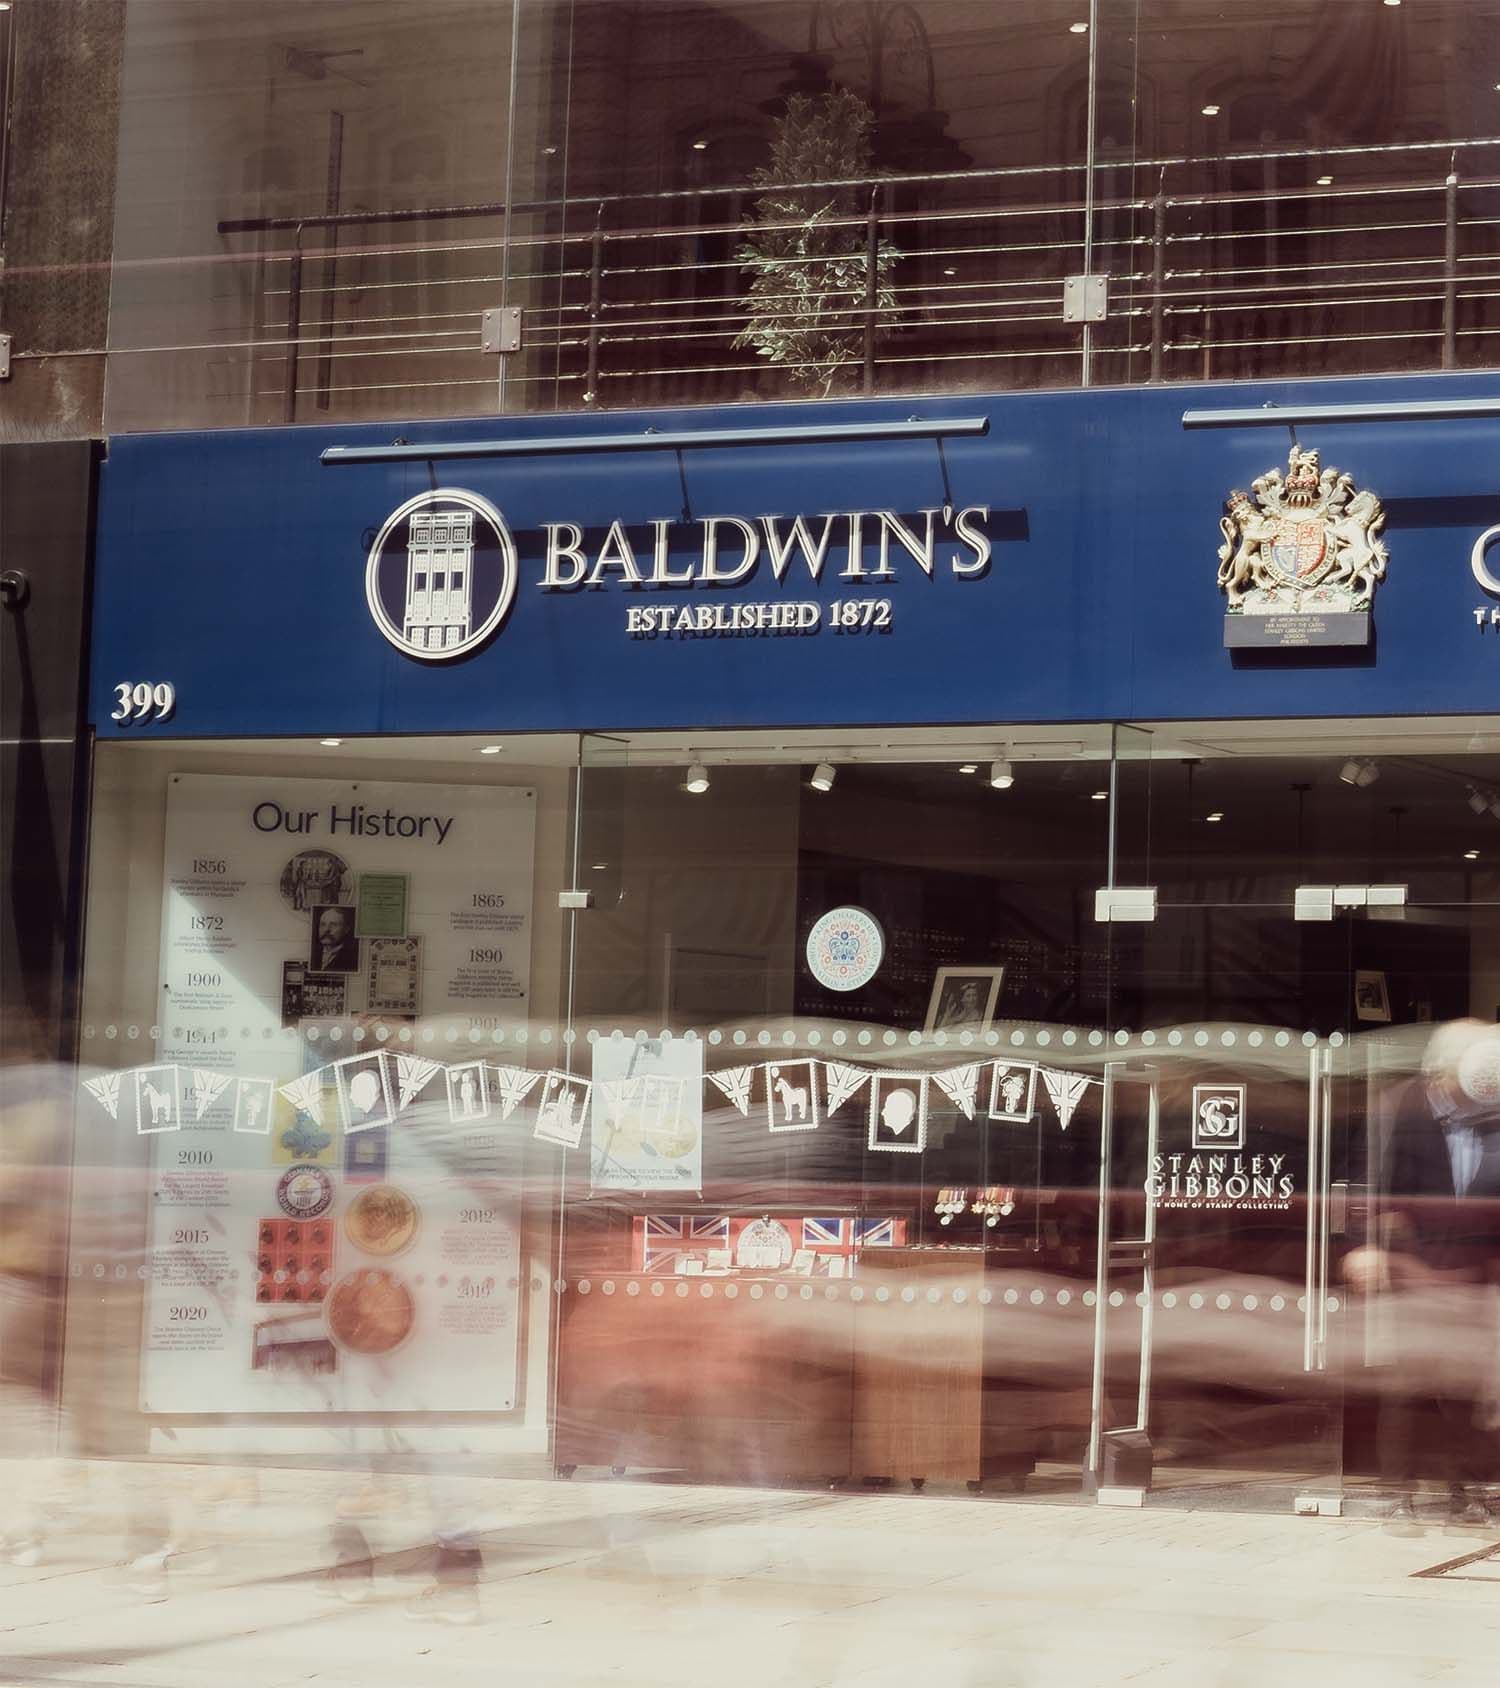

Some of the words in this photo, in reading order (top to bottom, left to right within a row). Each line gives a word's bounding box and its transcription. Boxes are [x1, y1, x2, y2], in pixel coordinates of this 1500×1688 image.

[537, 505, 991, 587] BALDWIN'S
[625, 600, 818, 632] ESTABLISHED
[829, 599, 891, 627] 1872
[111, 681, 174, 719] 399
[252, 801, 318, 833] Our
[331, 804, 453, 844] History
[193, 859, 226, 874] 1856
[472, 894, 505, 908] 1865
[191, 916, 224, 930] 1872
[470, 948, 503, 962] 1890
[187, 973, 221, 987] 1900
[178, 1150, 213, 1165] 2010
[1152, 1156, 1284, 1174] STANLEY
[1144, 1176, 1291, 1199] GIBBONS
[1236, 1202, 1290, 1210] COLLECTING
[175, 1229, 209, 1244] 2015
[169, 1306, 207, 1321] 2020
